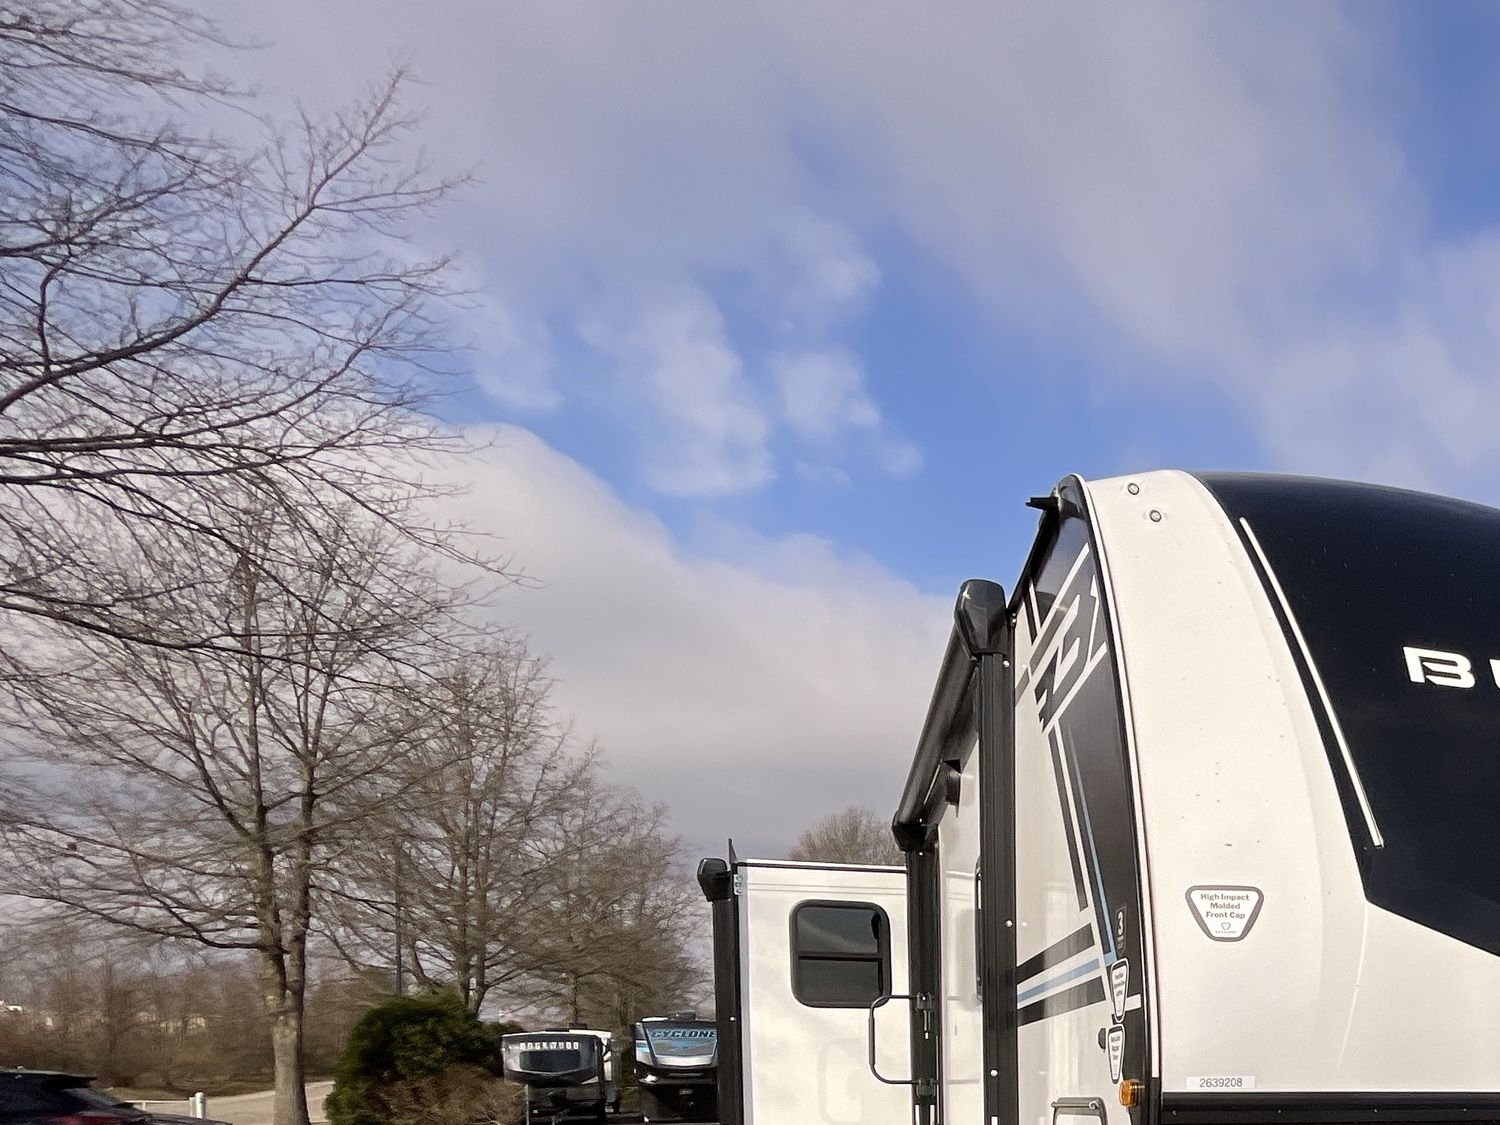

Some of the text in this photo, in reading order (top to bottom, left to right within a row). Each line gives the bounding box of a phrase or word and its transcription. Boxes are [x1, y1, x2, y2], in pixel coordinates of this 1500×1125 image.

[1200, 893, 1250, 901] High Impact
[1117, 911, 1124, 935] 3
[1199, 1077, 1243, 1088] 2639208
